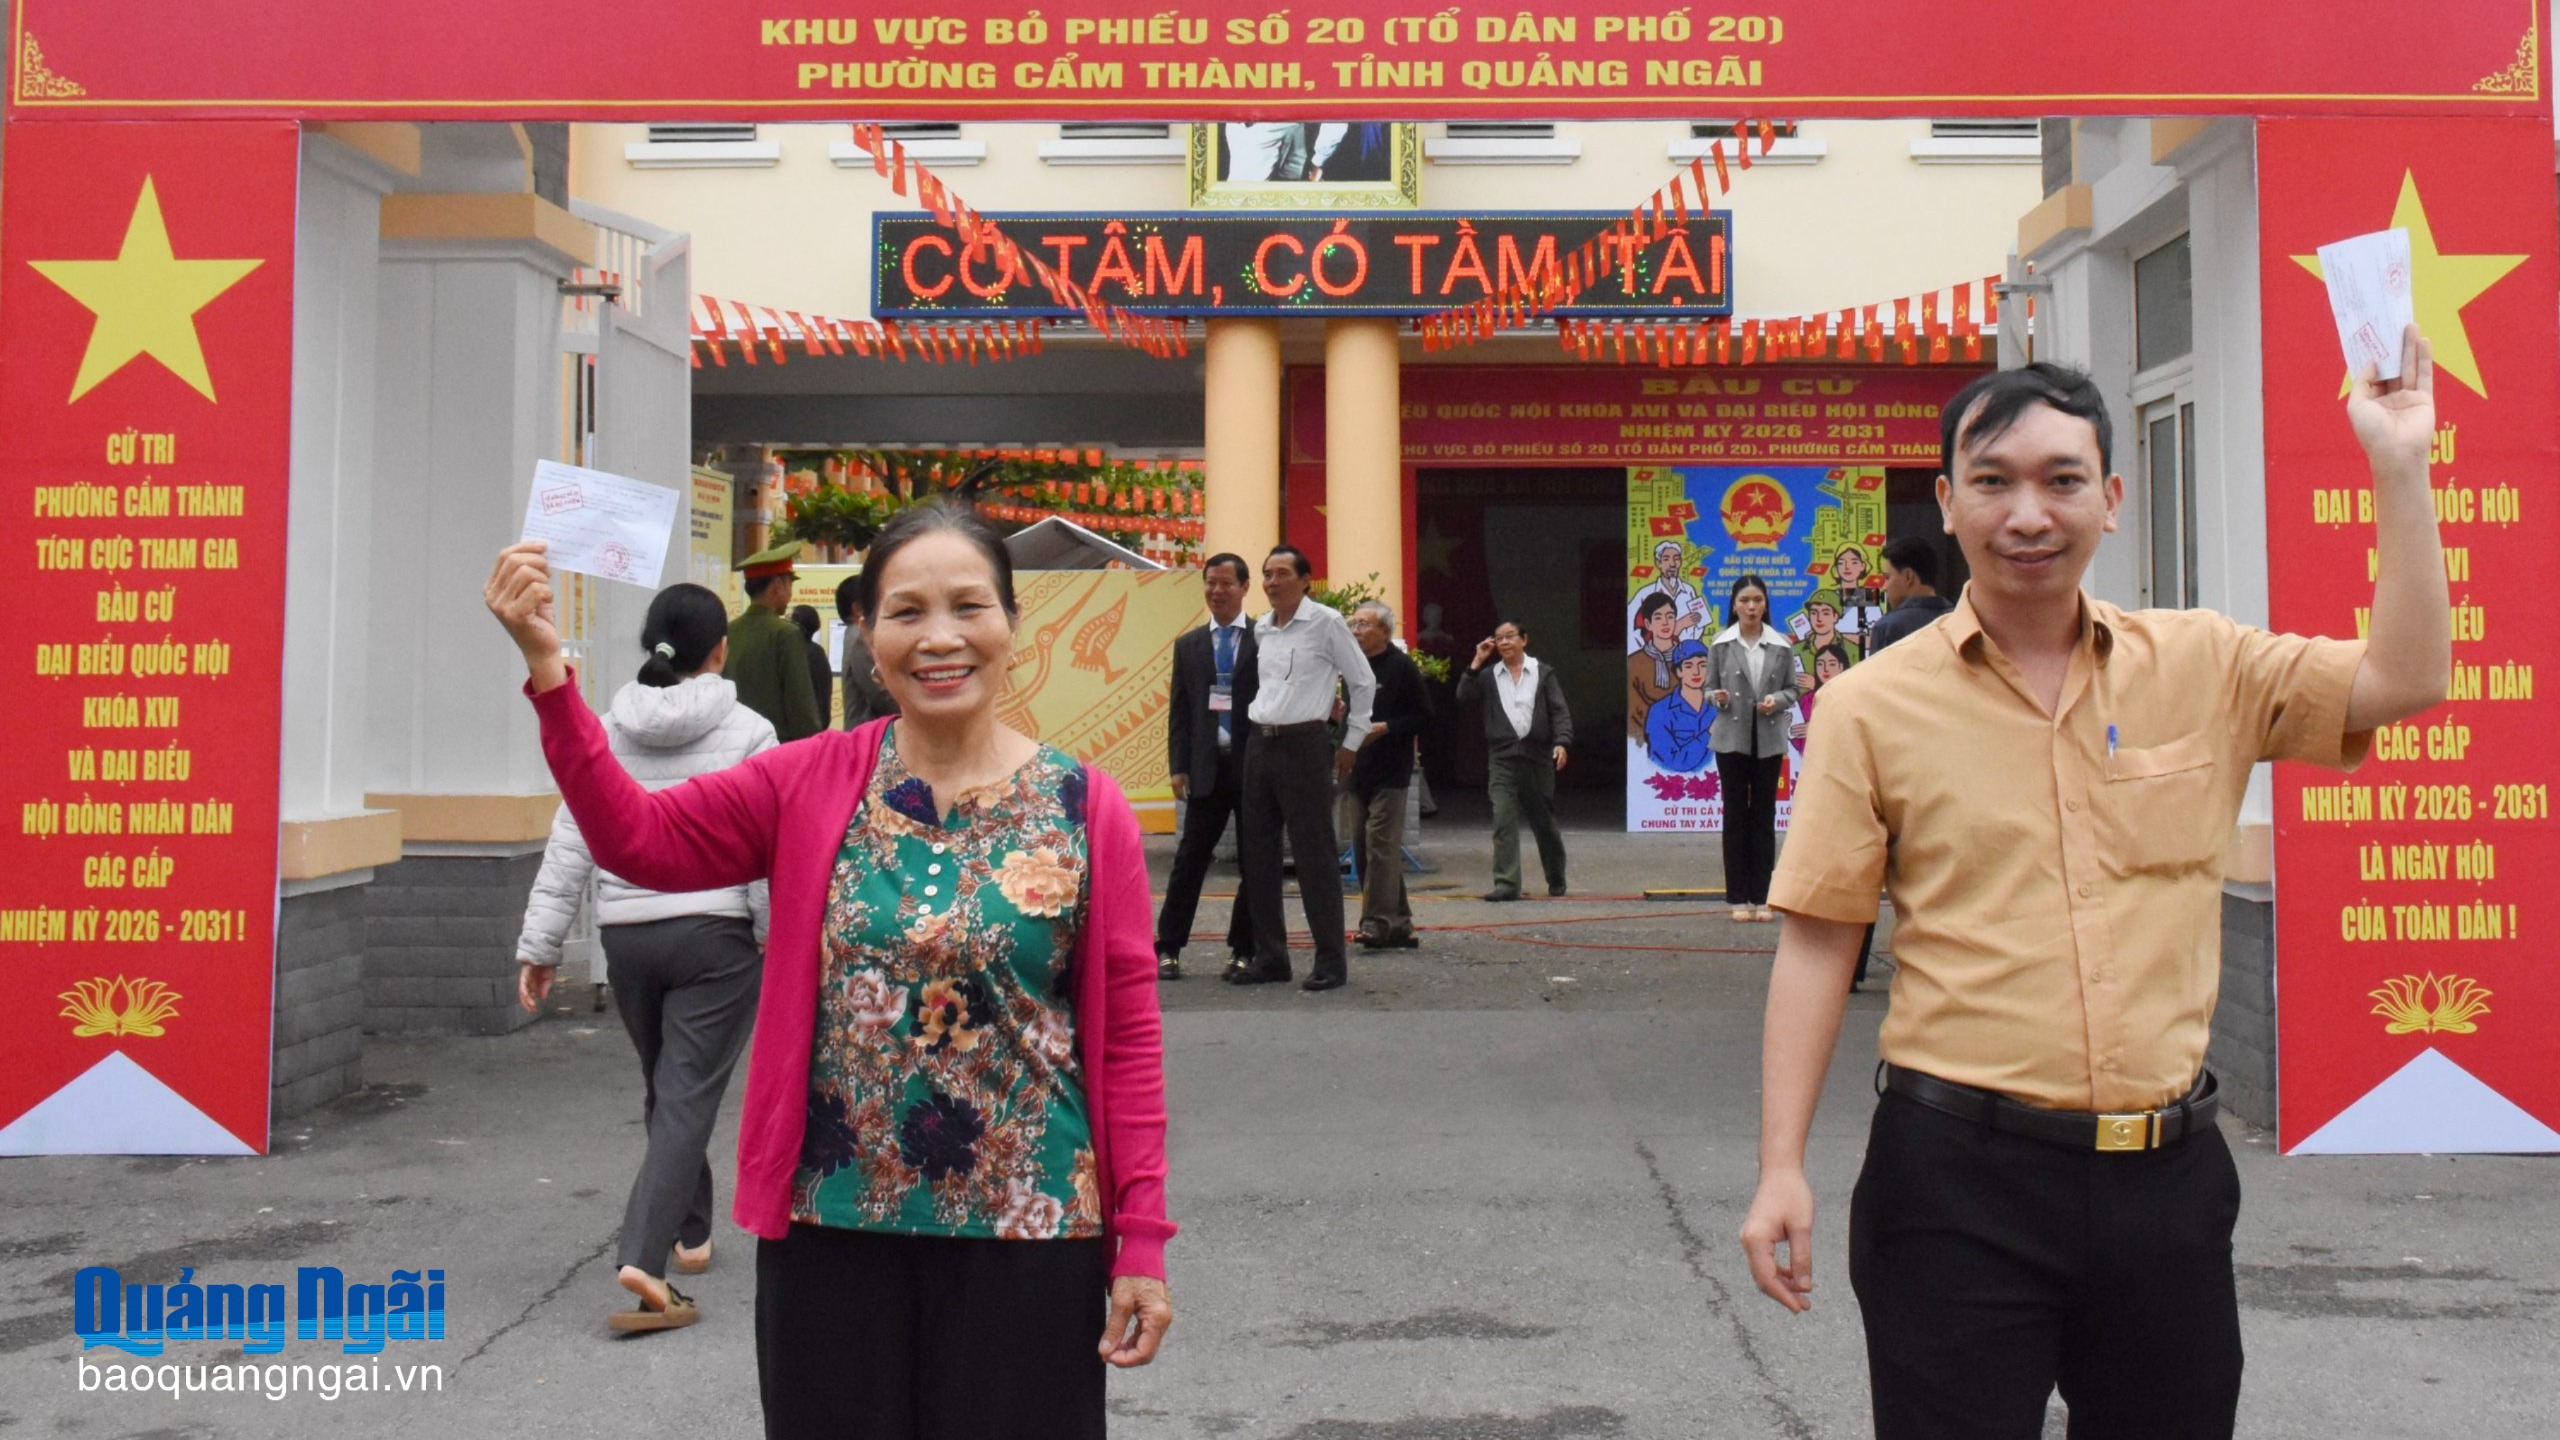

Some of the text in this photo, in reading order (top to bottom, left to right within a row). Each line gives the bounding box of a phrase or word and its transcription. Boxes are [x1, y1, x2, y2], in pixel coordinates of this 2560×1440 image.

[761, 8, 1784, 50] KHU VỰC BỎ PHIẾU SỐ 20 (TỔ DÂN PHỐ 20)
[798, 53, 1763, 91] PHƯỜNG CẨM THÀNH, TỈNH QUẢNG NGÃI
[1041, 220, 1223, 307] TÂM,
[1252, 219, 1368, 298] CÓ
[1619, 421, 1695, 441] NHIỆM
[1742, 423, 1803, 439] 2026
[1827, 423, 1885, 439] 2031
[1631, 403, 1669, 418] XVI
[106, 428, 175, 465] CỬ TRI
[1401, 443, 1427, 457] HU
[1588, 444, 1609, 456] 20
[34, 475, 244, 518] PHƯỜNG CẨM THÀNH
[2313, 488, 2352, 529] ĐẠI
[2431, 477, 2475, 522] UỐC
[2482, 482, 2520, 528] HỘI
[36, 534, 239, 575] TÍCH CỰC THAM GIA
[2442, 548, 2470, 582] VI
[96, 580, 176, 623] BẦU CỬ
[2450, 595, 2486, 641] IỂU
[36, 633, 230, 682] ĐẠI BIỂU QUỐC HỘI
[2489, 659, 2533, 700] DÂN
[83, 690, 179, 729] KHÓA XVI
[2376, 713, 2471, 761] CÁC CẤP
[68, 737, 191, 787] VÀ ĐẠI BIỂU
[22, 790, 233, 841] HỘI ĐỒNG NHÂN DÂN
[1640, 819, 1677, 829] CHUNG
[1680, 820, 1697, 829] TAY
[1681, 807, 1697, 816] TRI
[2302, 780, 2372, 827] NHIỆM
[2380, 780, 2407, 821] KỲ
[2415, 786, 2472, 821] 2026
[2494, 784, 2548, 820] 2031
[83, 846, 174, 889] CÁC CẤP
[2360, 838, 2495, 884] LÀ NGÀY HỘI
[0, 903, 246, 947] NHIỆM KỲ 2026 - 2031 !
[2341, 897, 2517, 942] CỦA TOÀN DÂN !
